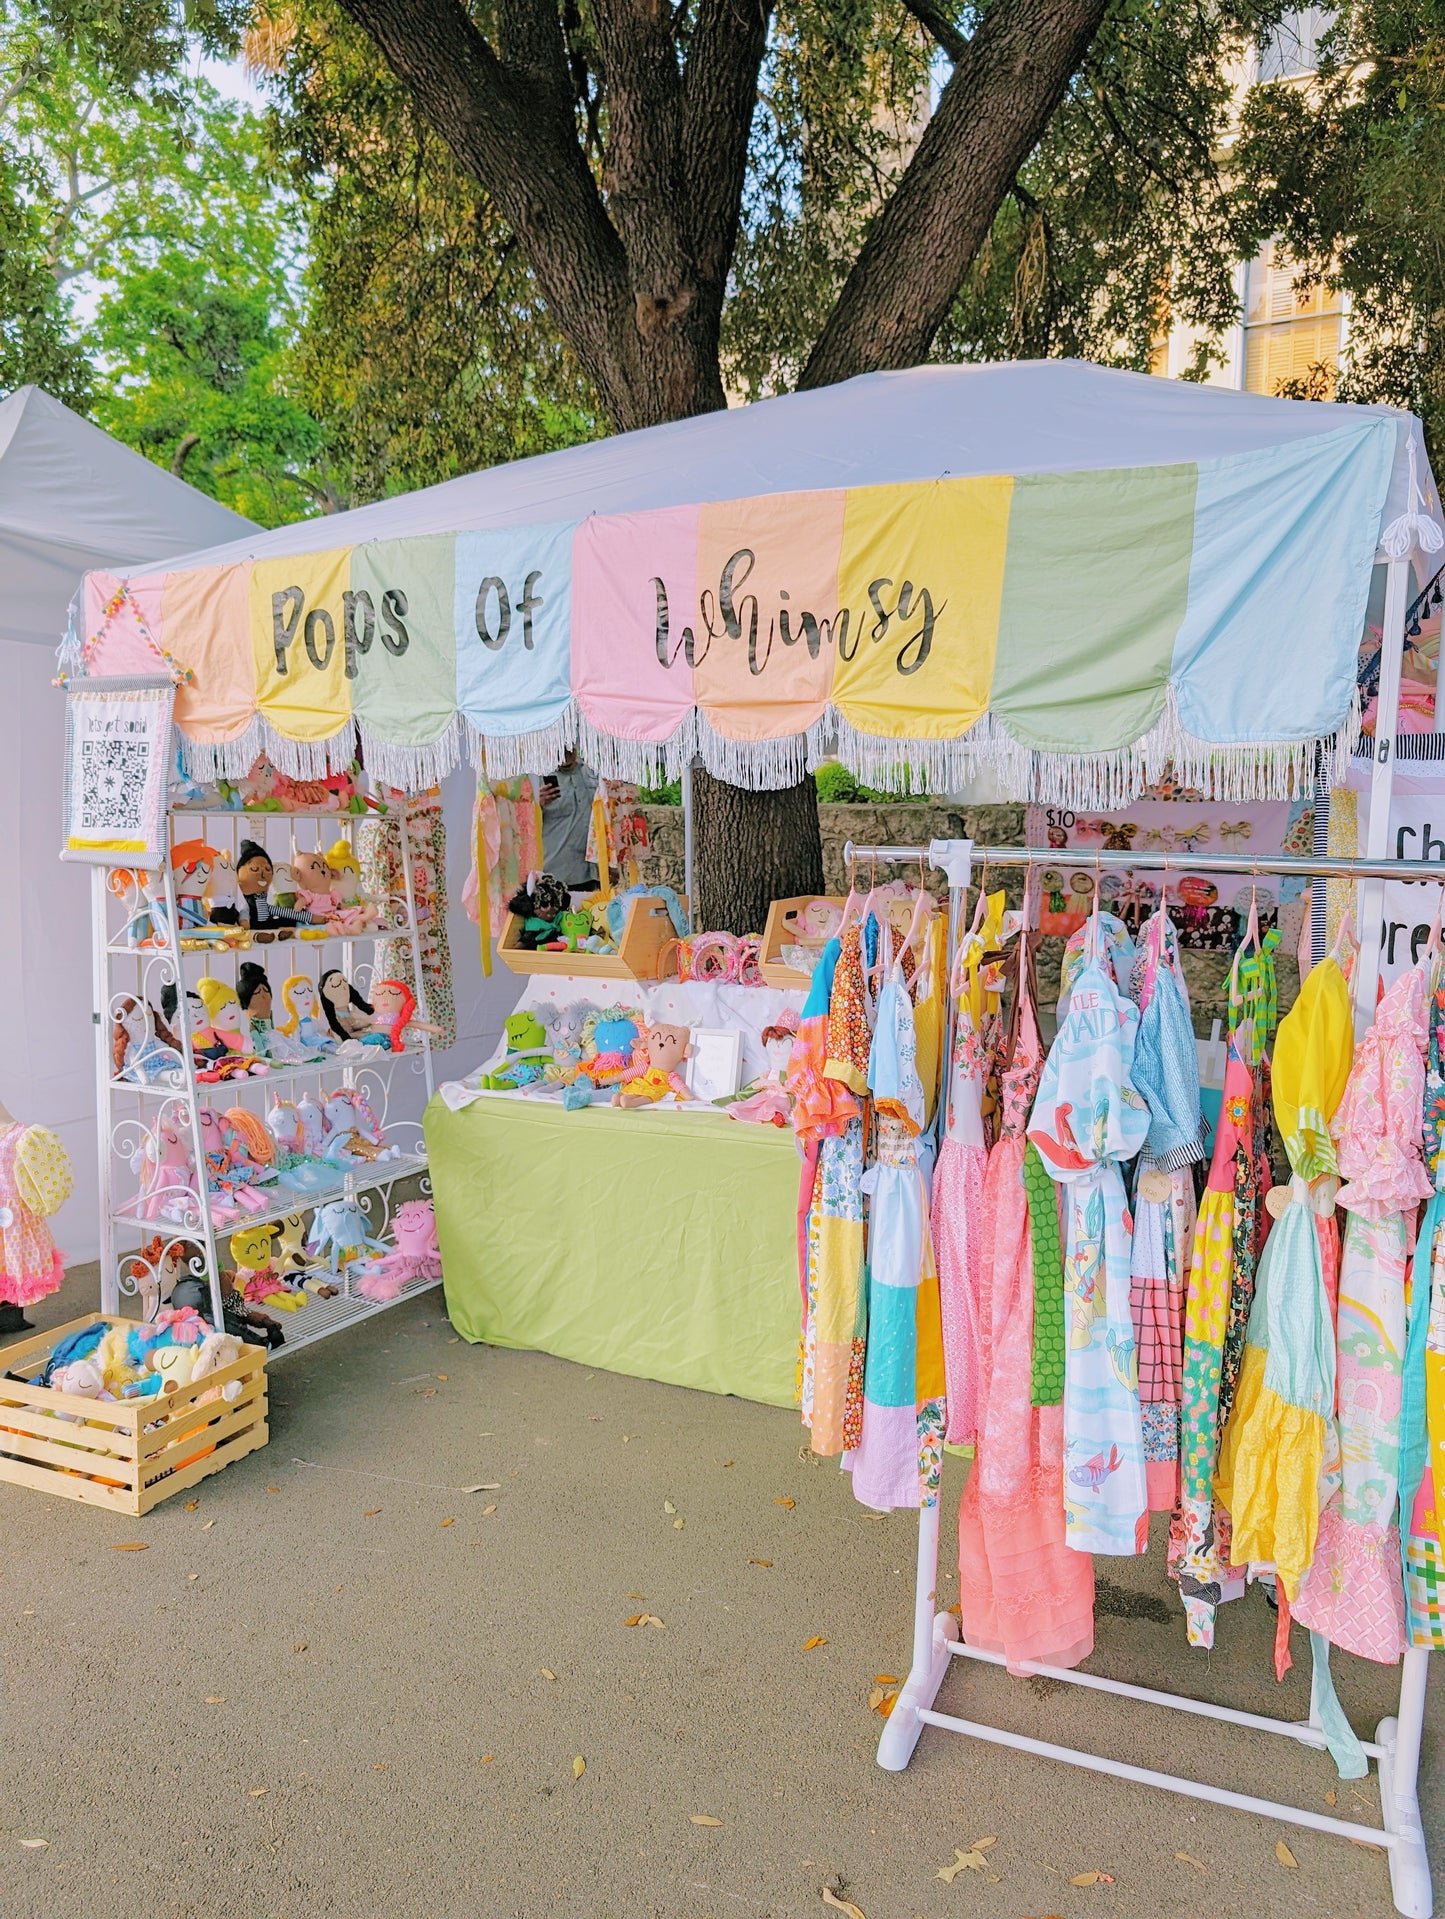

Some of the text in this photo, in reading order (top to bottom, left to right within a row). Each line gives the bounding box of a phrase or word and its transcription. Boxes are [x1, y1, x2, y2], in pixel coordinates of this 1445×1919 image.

[271, 548, 948, 680] Pops Of Whimsy
[103, 715, 120, 737] get
[1046, 809, 1075, 828] $10
